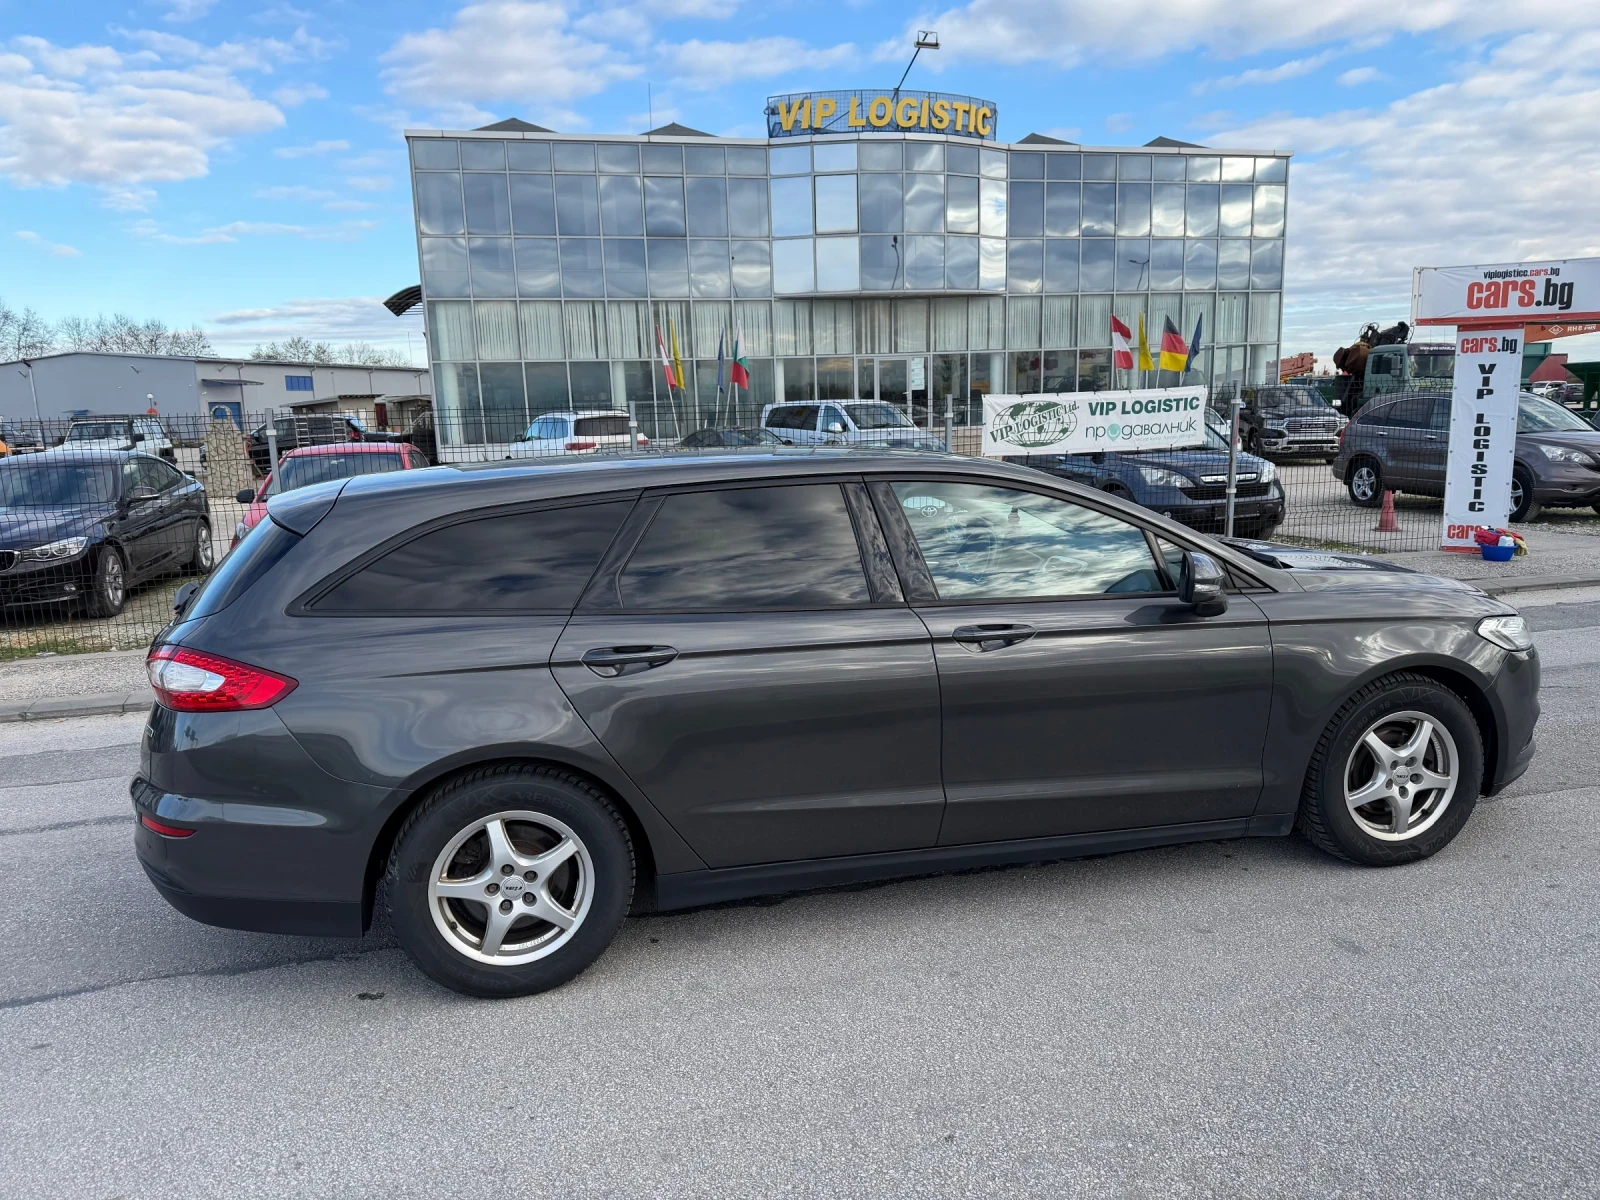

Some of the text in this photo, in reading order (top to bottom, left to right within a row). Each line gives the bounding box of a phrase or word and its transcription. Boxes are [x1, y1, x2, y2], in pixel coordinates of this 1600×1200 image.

[777, 96, 992, 136] VIP LOGISTIC
[1484, 267, 1560, 280] viplogisticc.cars.bg
[1466, 278, 1574, 310] cars.bg
[1461, 337, 1518, 354] cars.bg
[990, 401, 1080, 443] VIP LOGISTIC Ltd.
[1088, 397, 1200, 416] VIP LOGISTIC
[1468, 363, 1497, 512] VIP LOGISTIC
